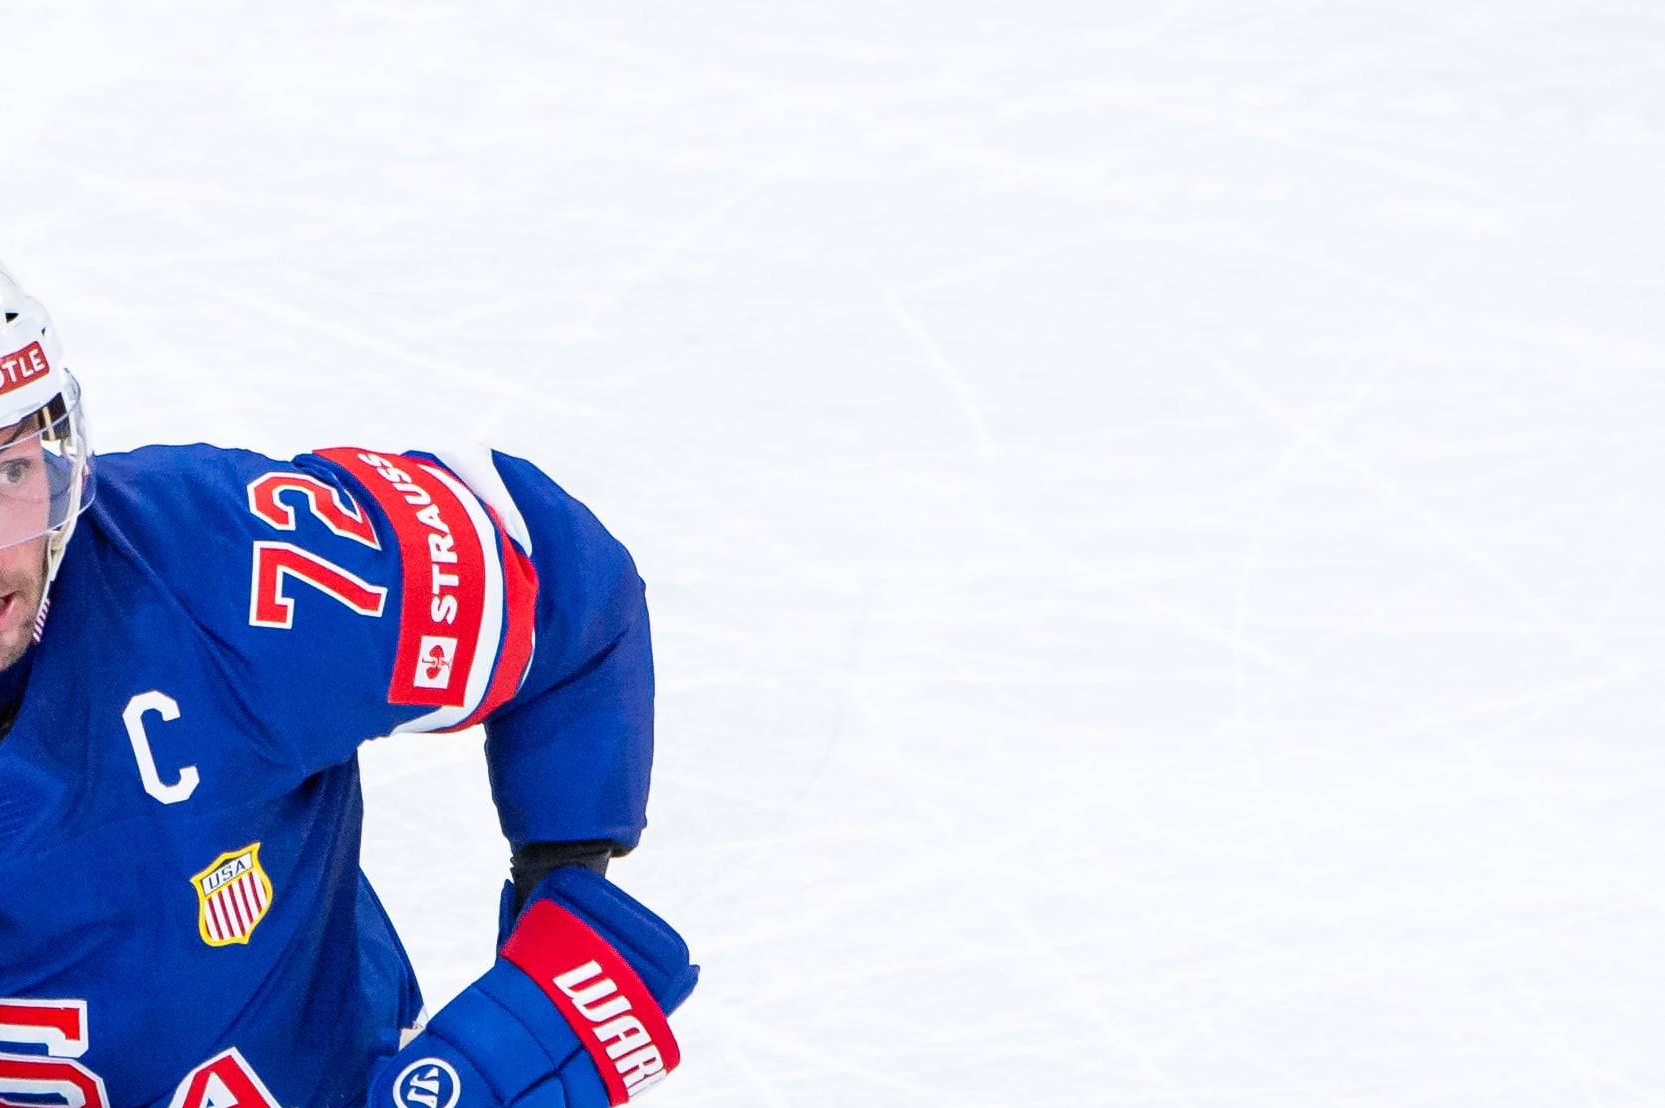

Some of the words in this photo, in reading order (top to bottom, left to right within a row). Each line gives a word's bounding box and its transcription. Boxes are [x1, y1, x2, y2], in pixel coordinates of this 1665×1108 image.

[246, 471, 388, 629] 72
[358, 453, 459, 625] STRAUSS
[122, 690, 200, 805] C
[209, 859, 246, 889] USA
